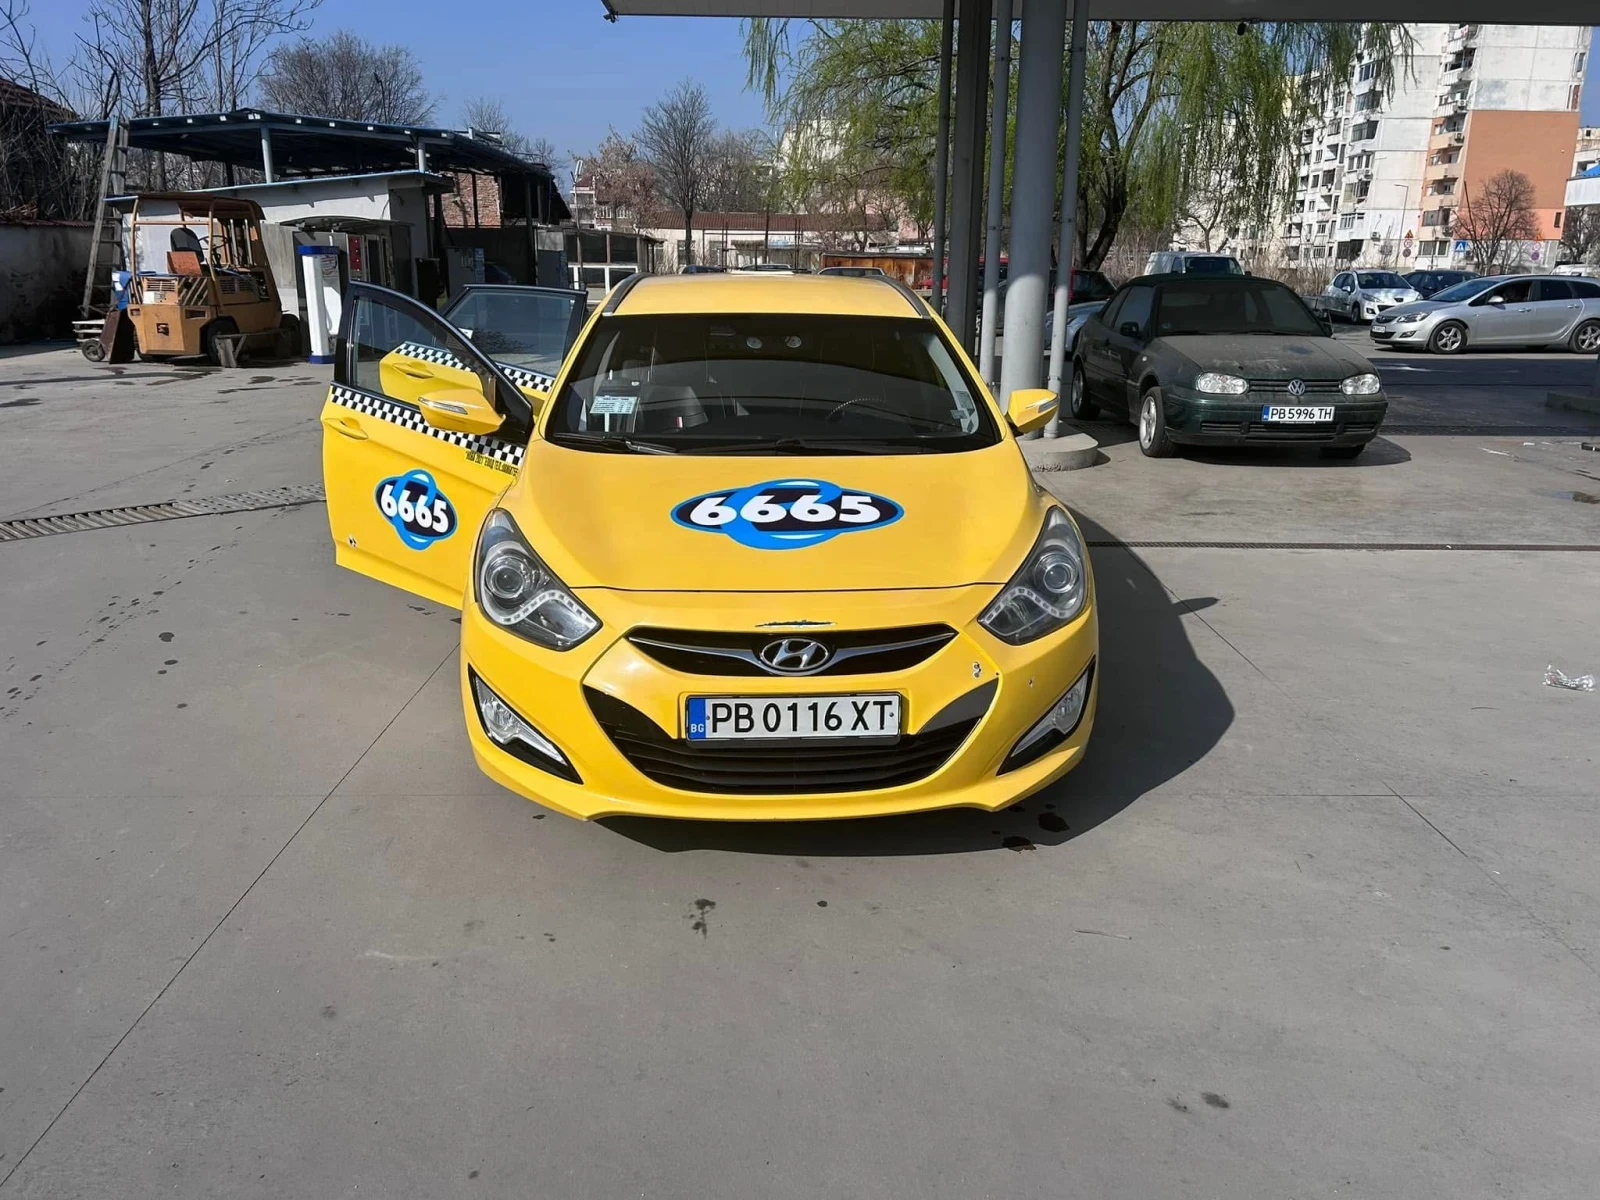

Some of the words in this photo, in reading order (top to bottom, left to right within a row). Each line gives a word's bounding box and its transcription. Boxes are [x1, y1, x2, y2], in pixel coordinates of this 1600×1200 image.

[1271, 408, 1286, 419] PB
[1287, 408, 1315, 419] 5996
[1318, 408, 1332, 419] TH
[380, 484, 449, 533] 6665
[690, 494, 881, 526] 6665
[690, 724, 705, 733] BG
[712, 702, 754, 733] PB
[762, 702, 843, 733] 0116
[851, 700, 893, 731] XT
